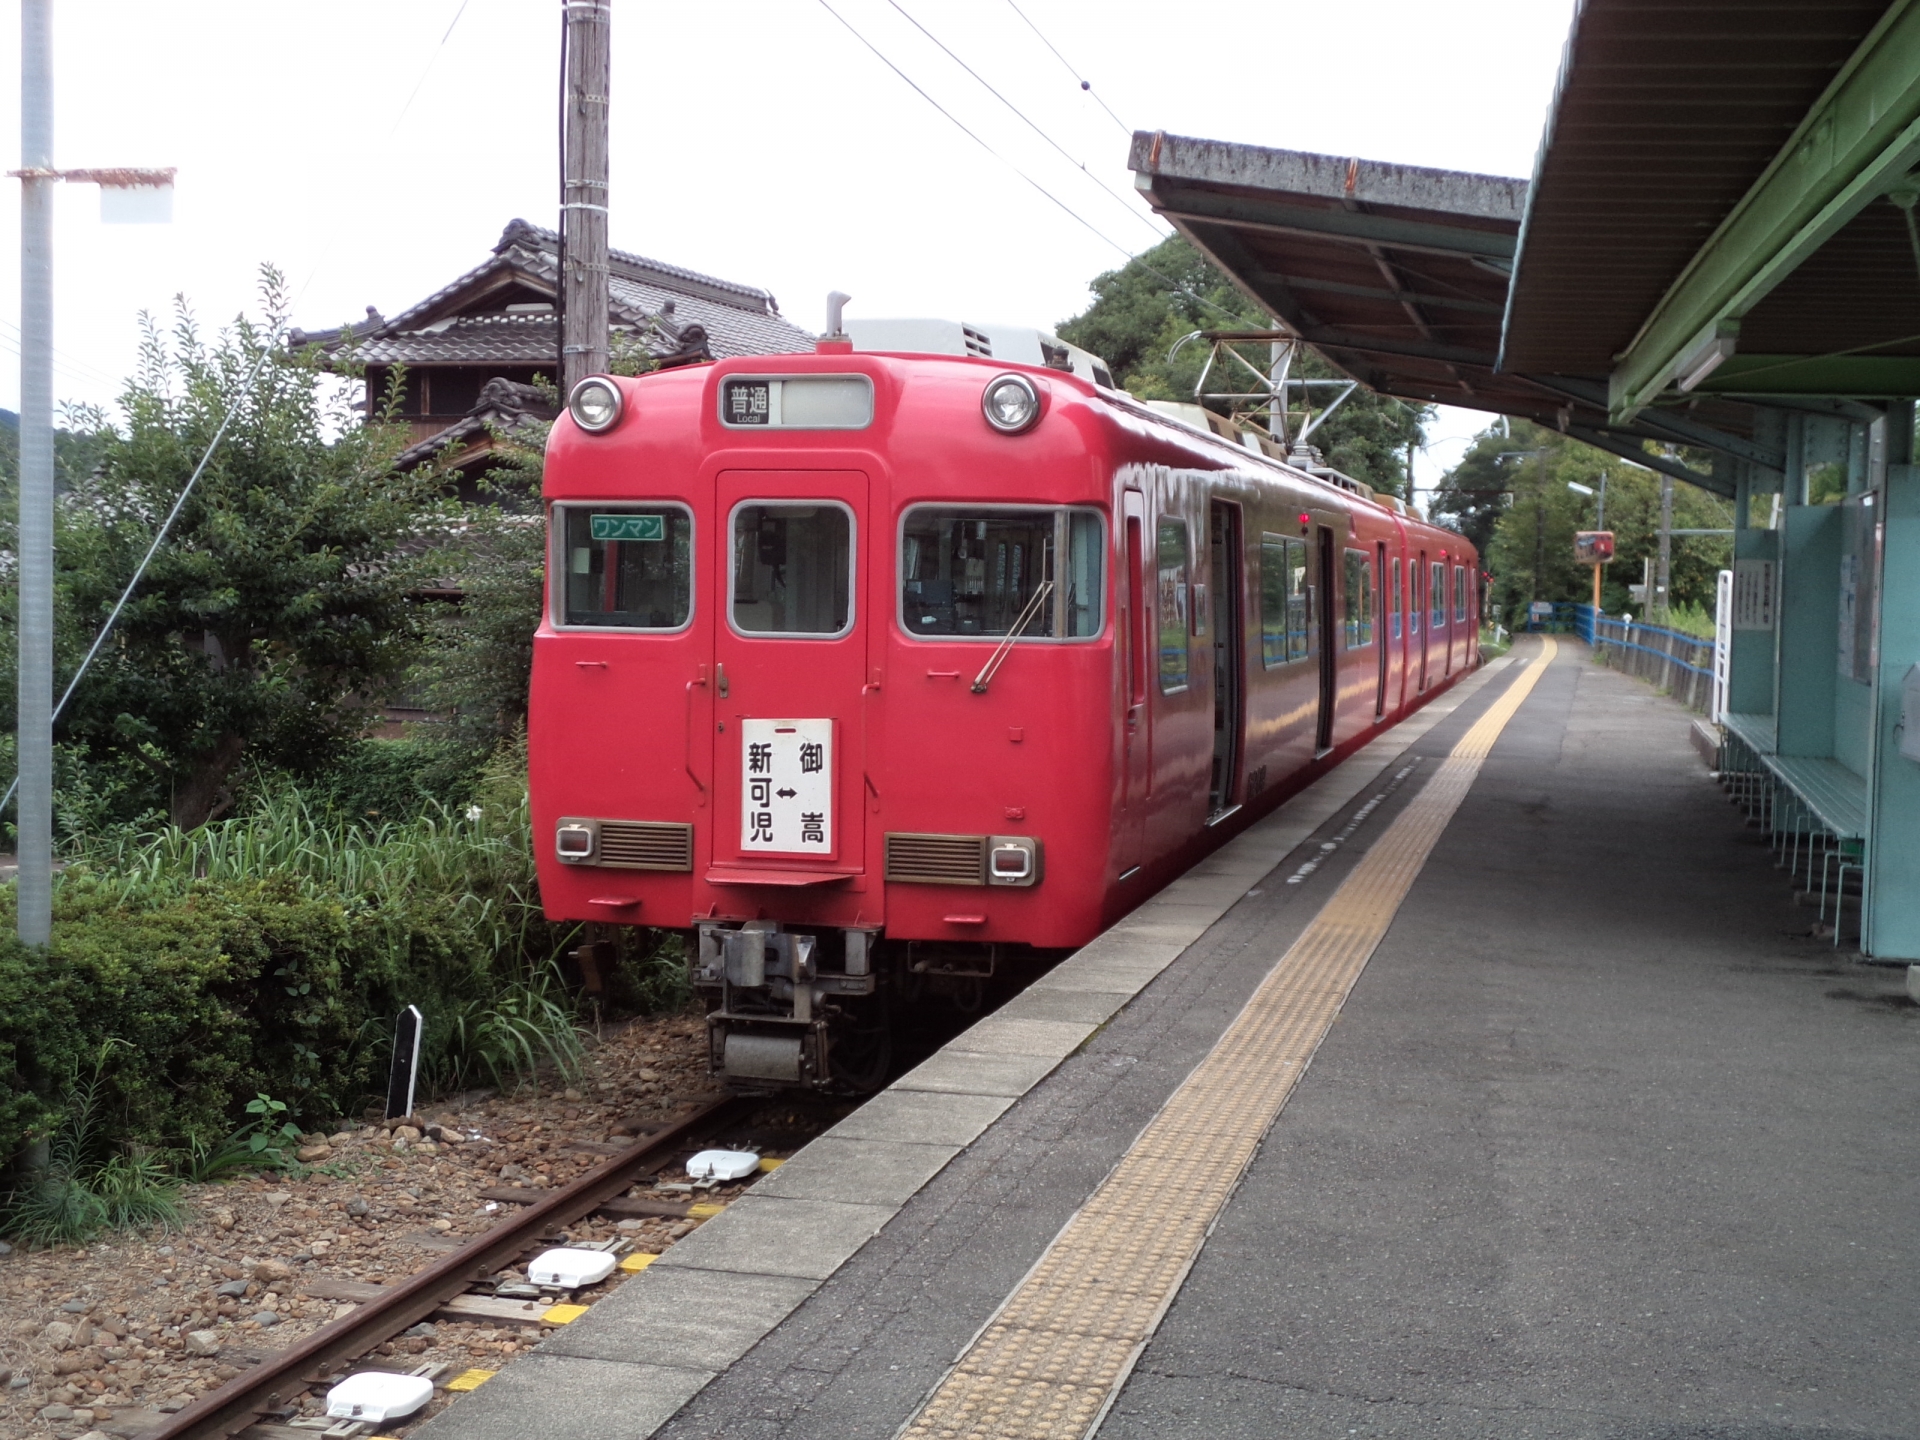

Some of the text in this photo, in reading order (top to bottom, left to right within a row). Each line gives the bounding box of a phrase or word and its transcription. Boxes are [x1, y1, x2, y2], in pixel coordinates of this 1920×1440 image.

[731, 386, 768, 414] 普通
[736, 413, 760, 424] Local
[593, 518, 660, 537] ワンマン
[748, 742, 774, 843] 新可児
[798, 742, 825, 844] 御嵩
